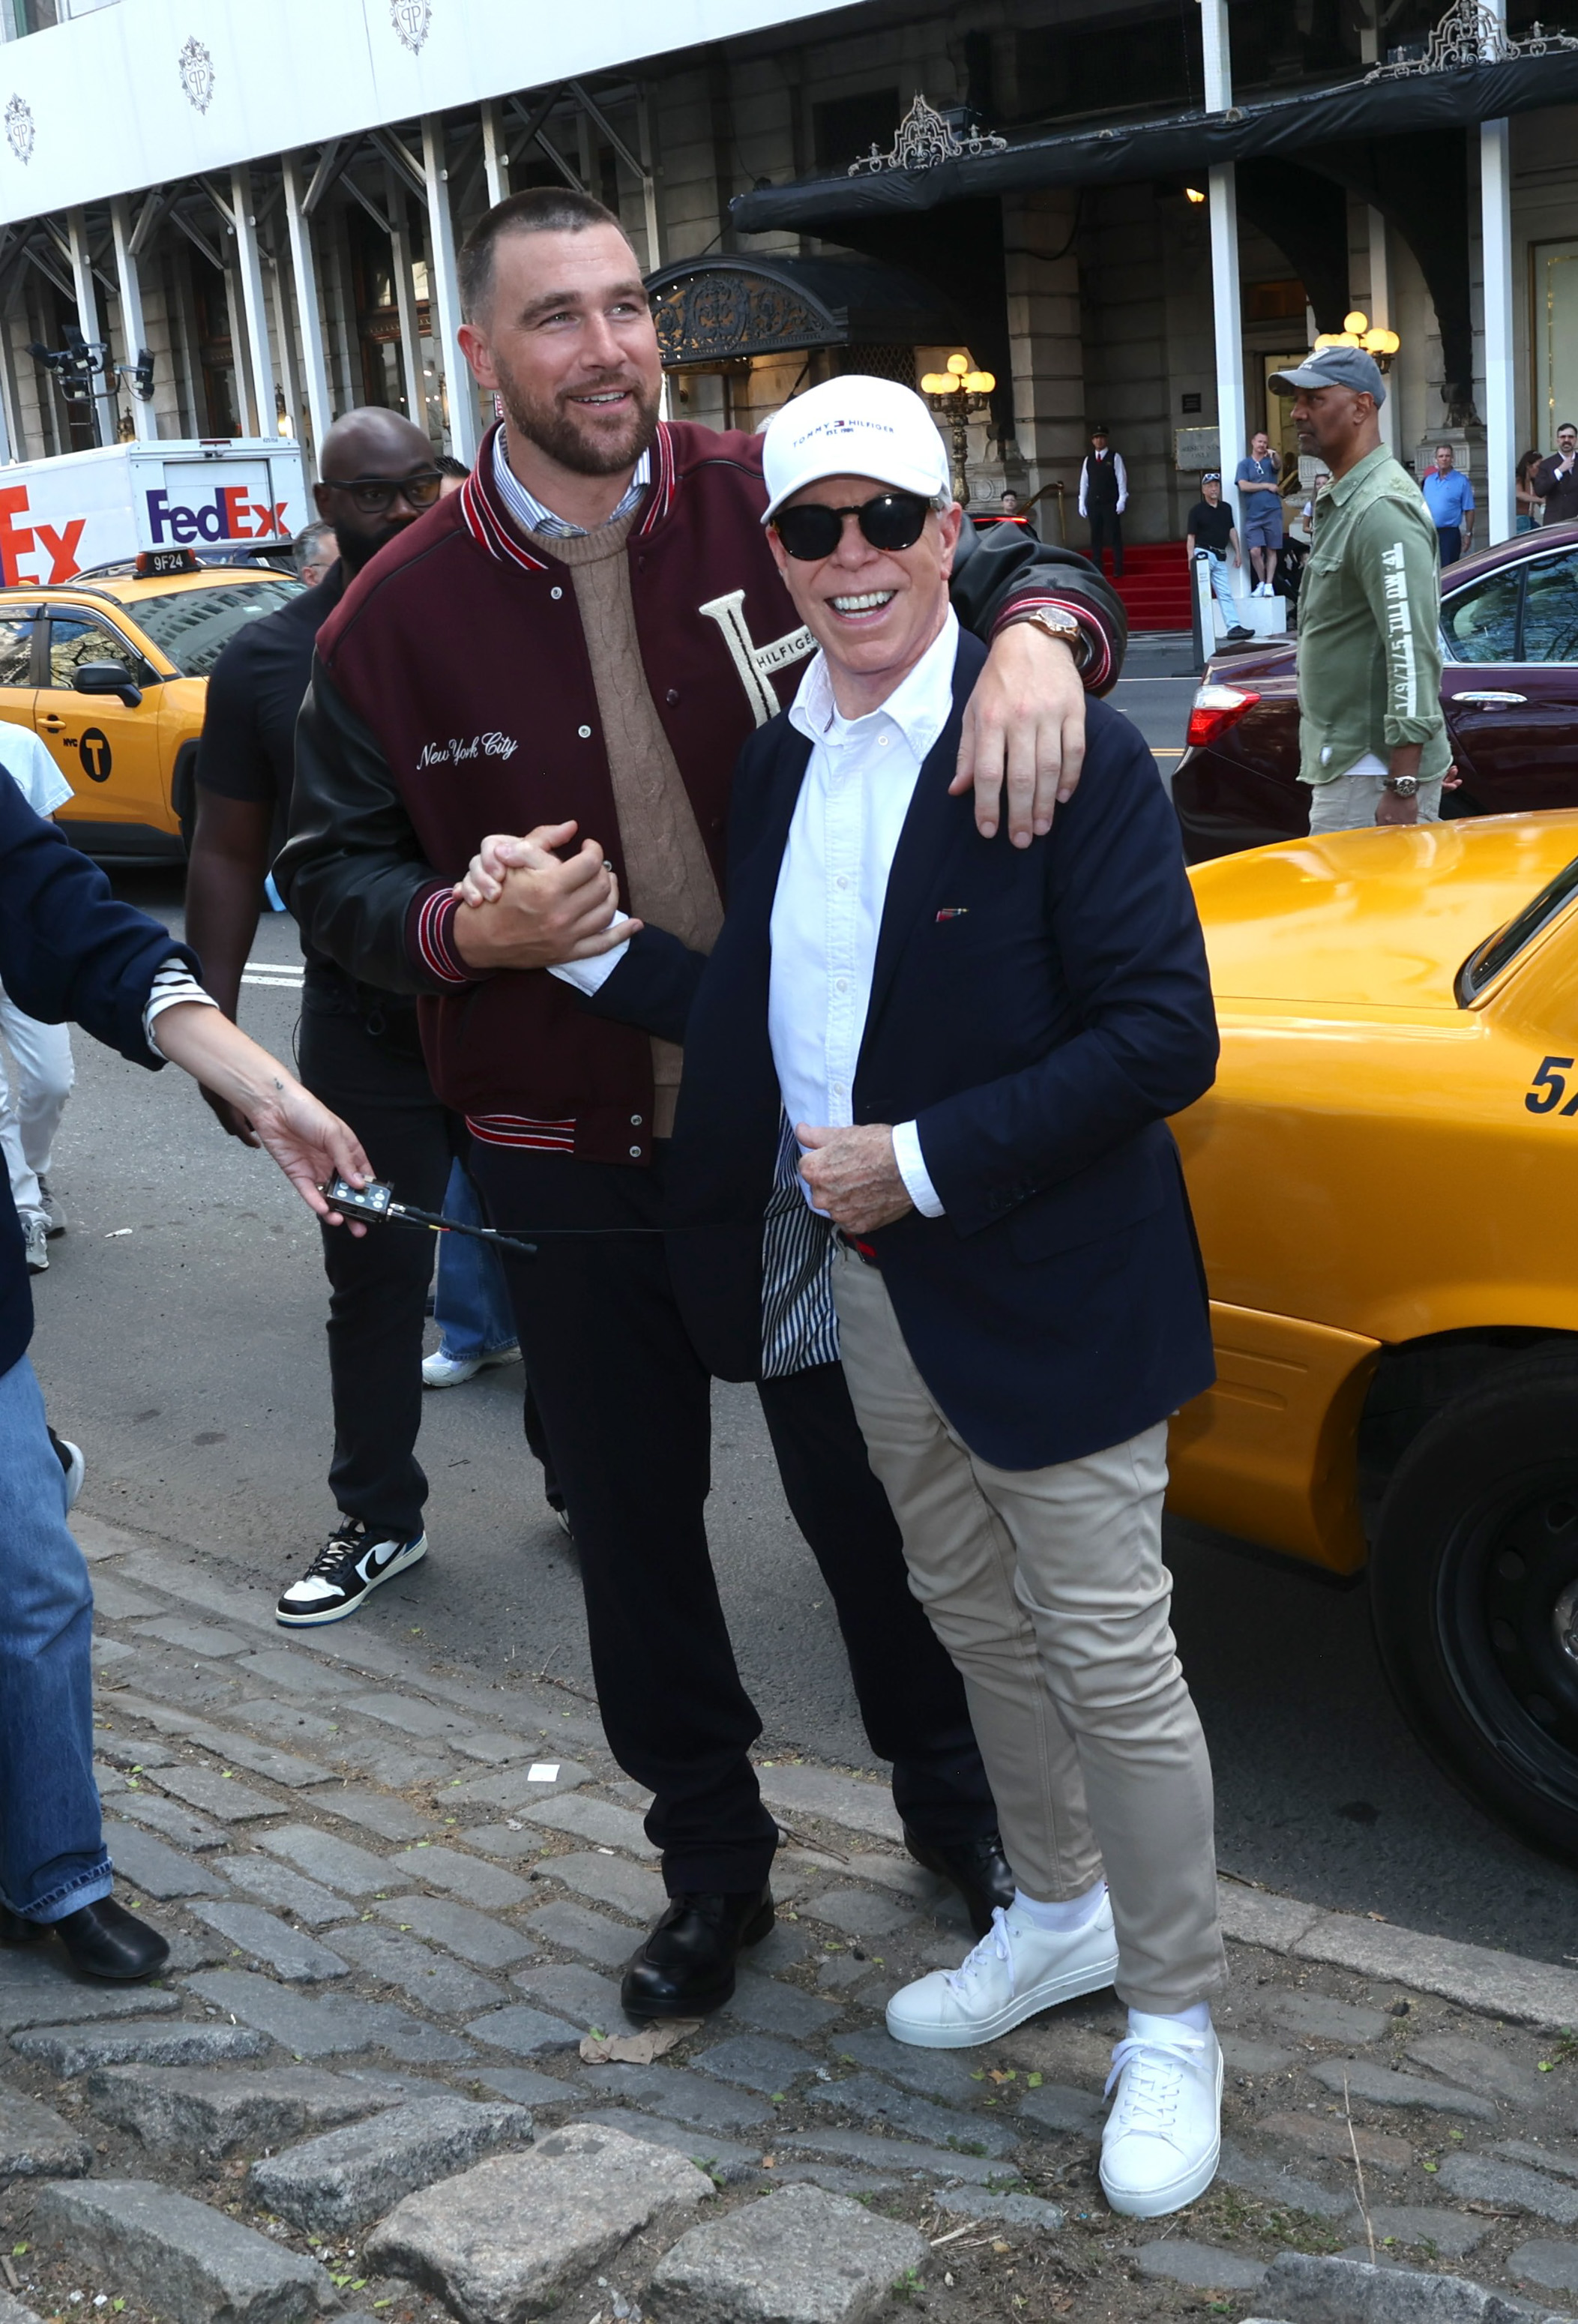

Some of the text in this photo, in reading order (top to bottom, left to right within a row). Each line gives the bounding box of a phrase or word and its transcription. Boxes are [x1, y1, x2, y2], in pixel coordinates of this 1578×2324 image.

[793, 420, 894, 448] TOMMY HILFIGER
[146, 486, 292, 544] FedEx
[0, 484, 86, 586] Ex
[154, 553, 184, 571] 9F24
[63, 738, 78, 747] NYC
[416, 732, 519, 770] New York City
